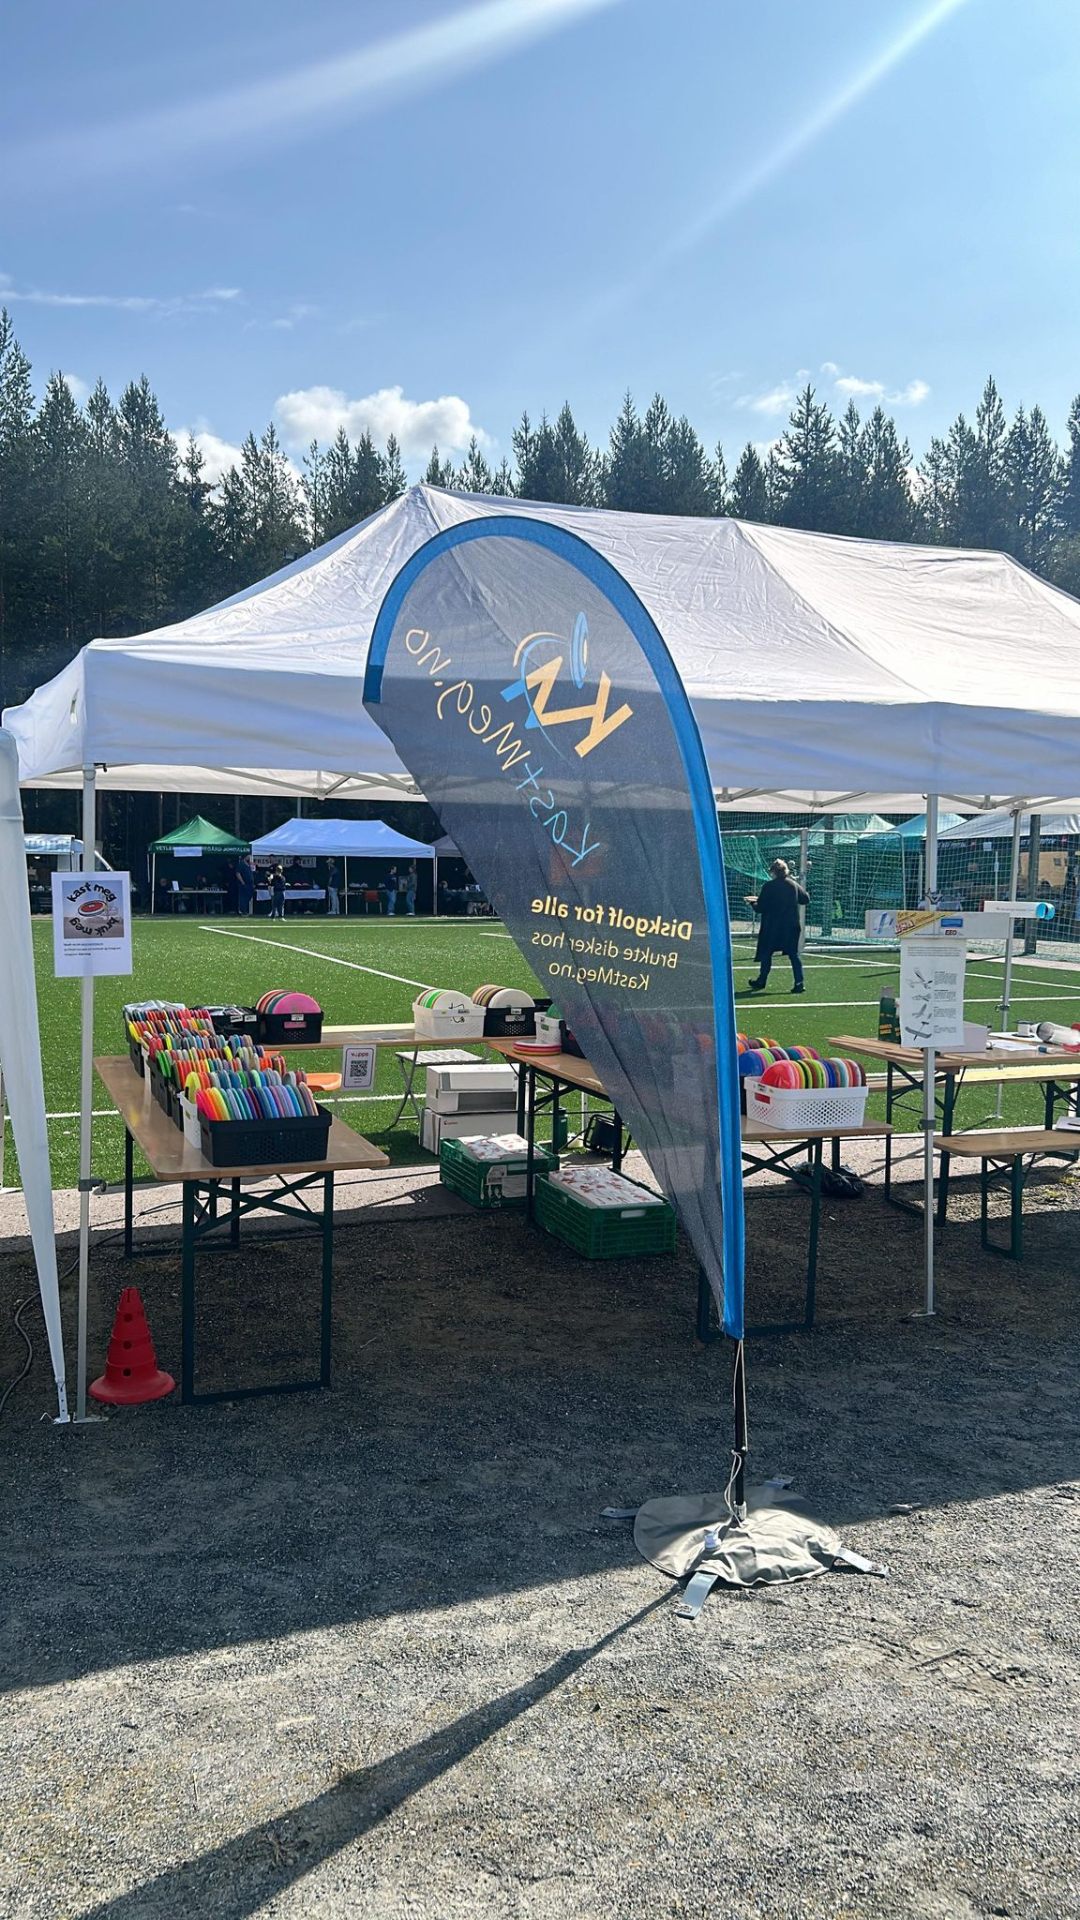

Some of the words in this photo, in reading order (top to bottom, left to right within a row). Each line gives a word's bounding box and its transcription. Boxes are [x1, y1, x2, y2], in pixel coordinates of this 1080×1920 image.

[66, 881, 92, 903] kast
[93, 883, 117, 903] meg
[69, 916, 93, 936] meg
